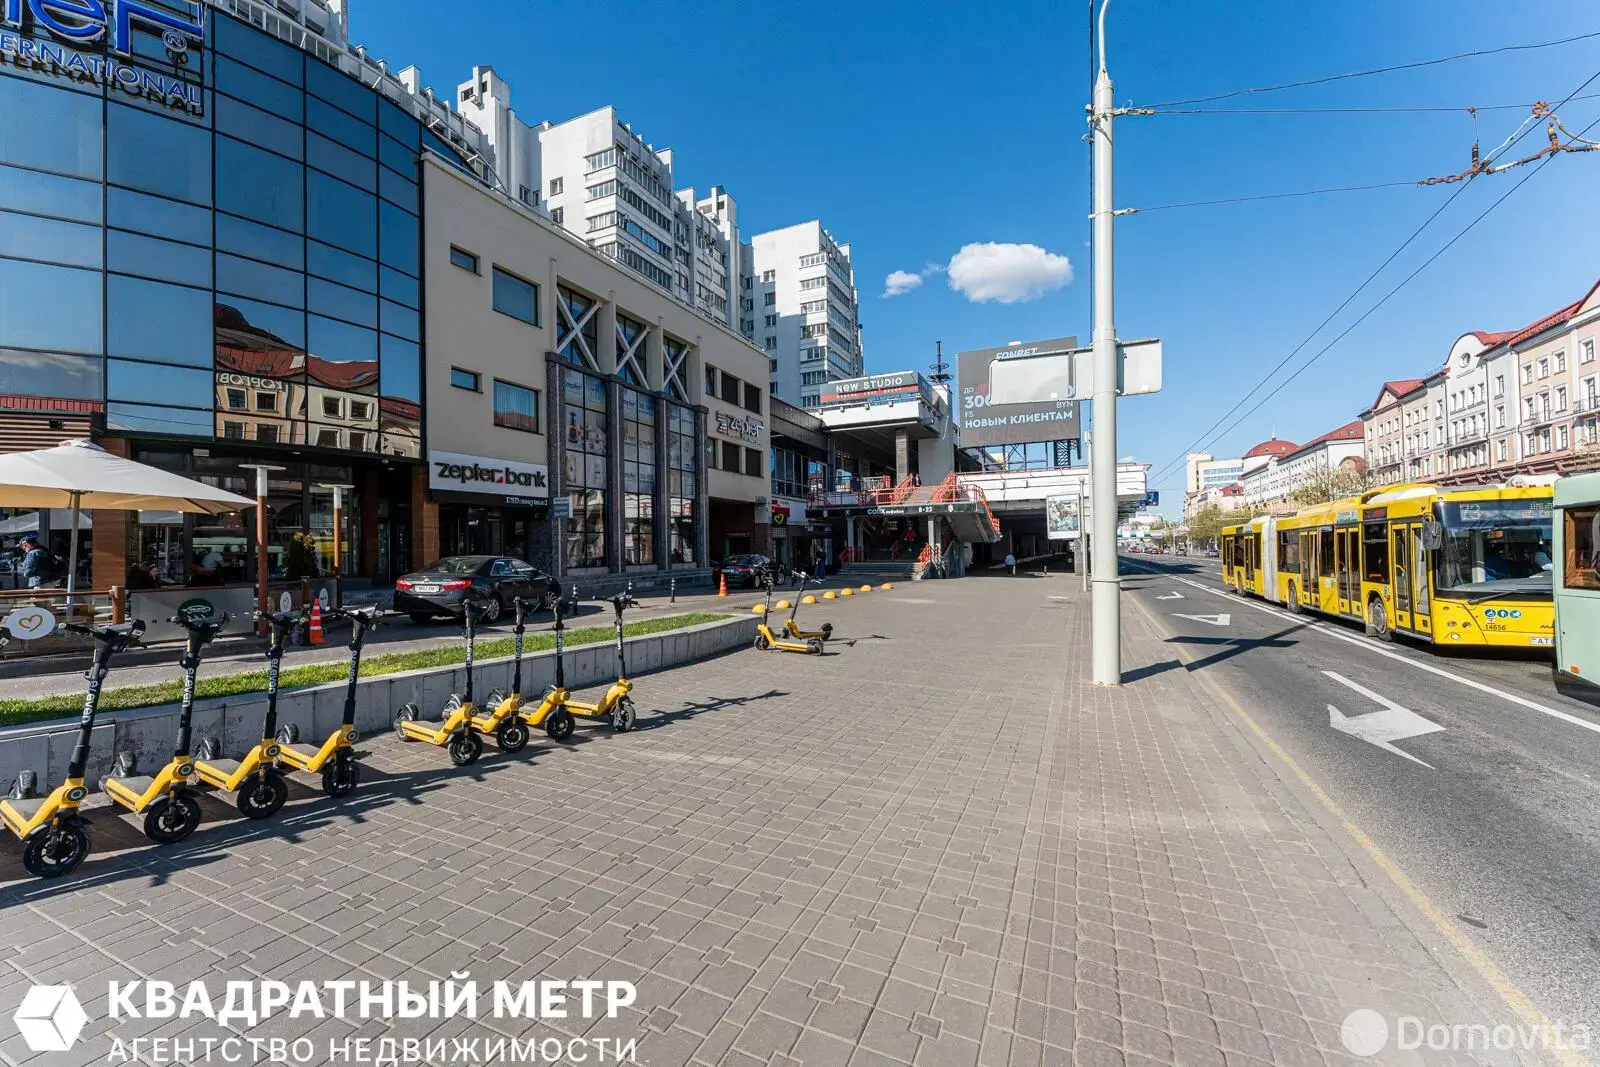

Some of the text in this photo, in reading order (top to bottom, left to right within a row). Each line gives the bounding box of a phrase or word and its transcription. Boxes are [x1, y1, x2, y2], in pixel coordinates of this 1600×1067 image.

[863, 376, 903, 390] STUDIO
[963, 386, 975, 394] ДО
[1056, 400, 1074, 409] BYN
[965, 410, 1073, 428] НОВЫМ КЛИЕНТАМ
